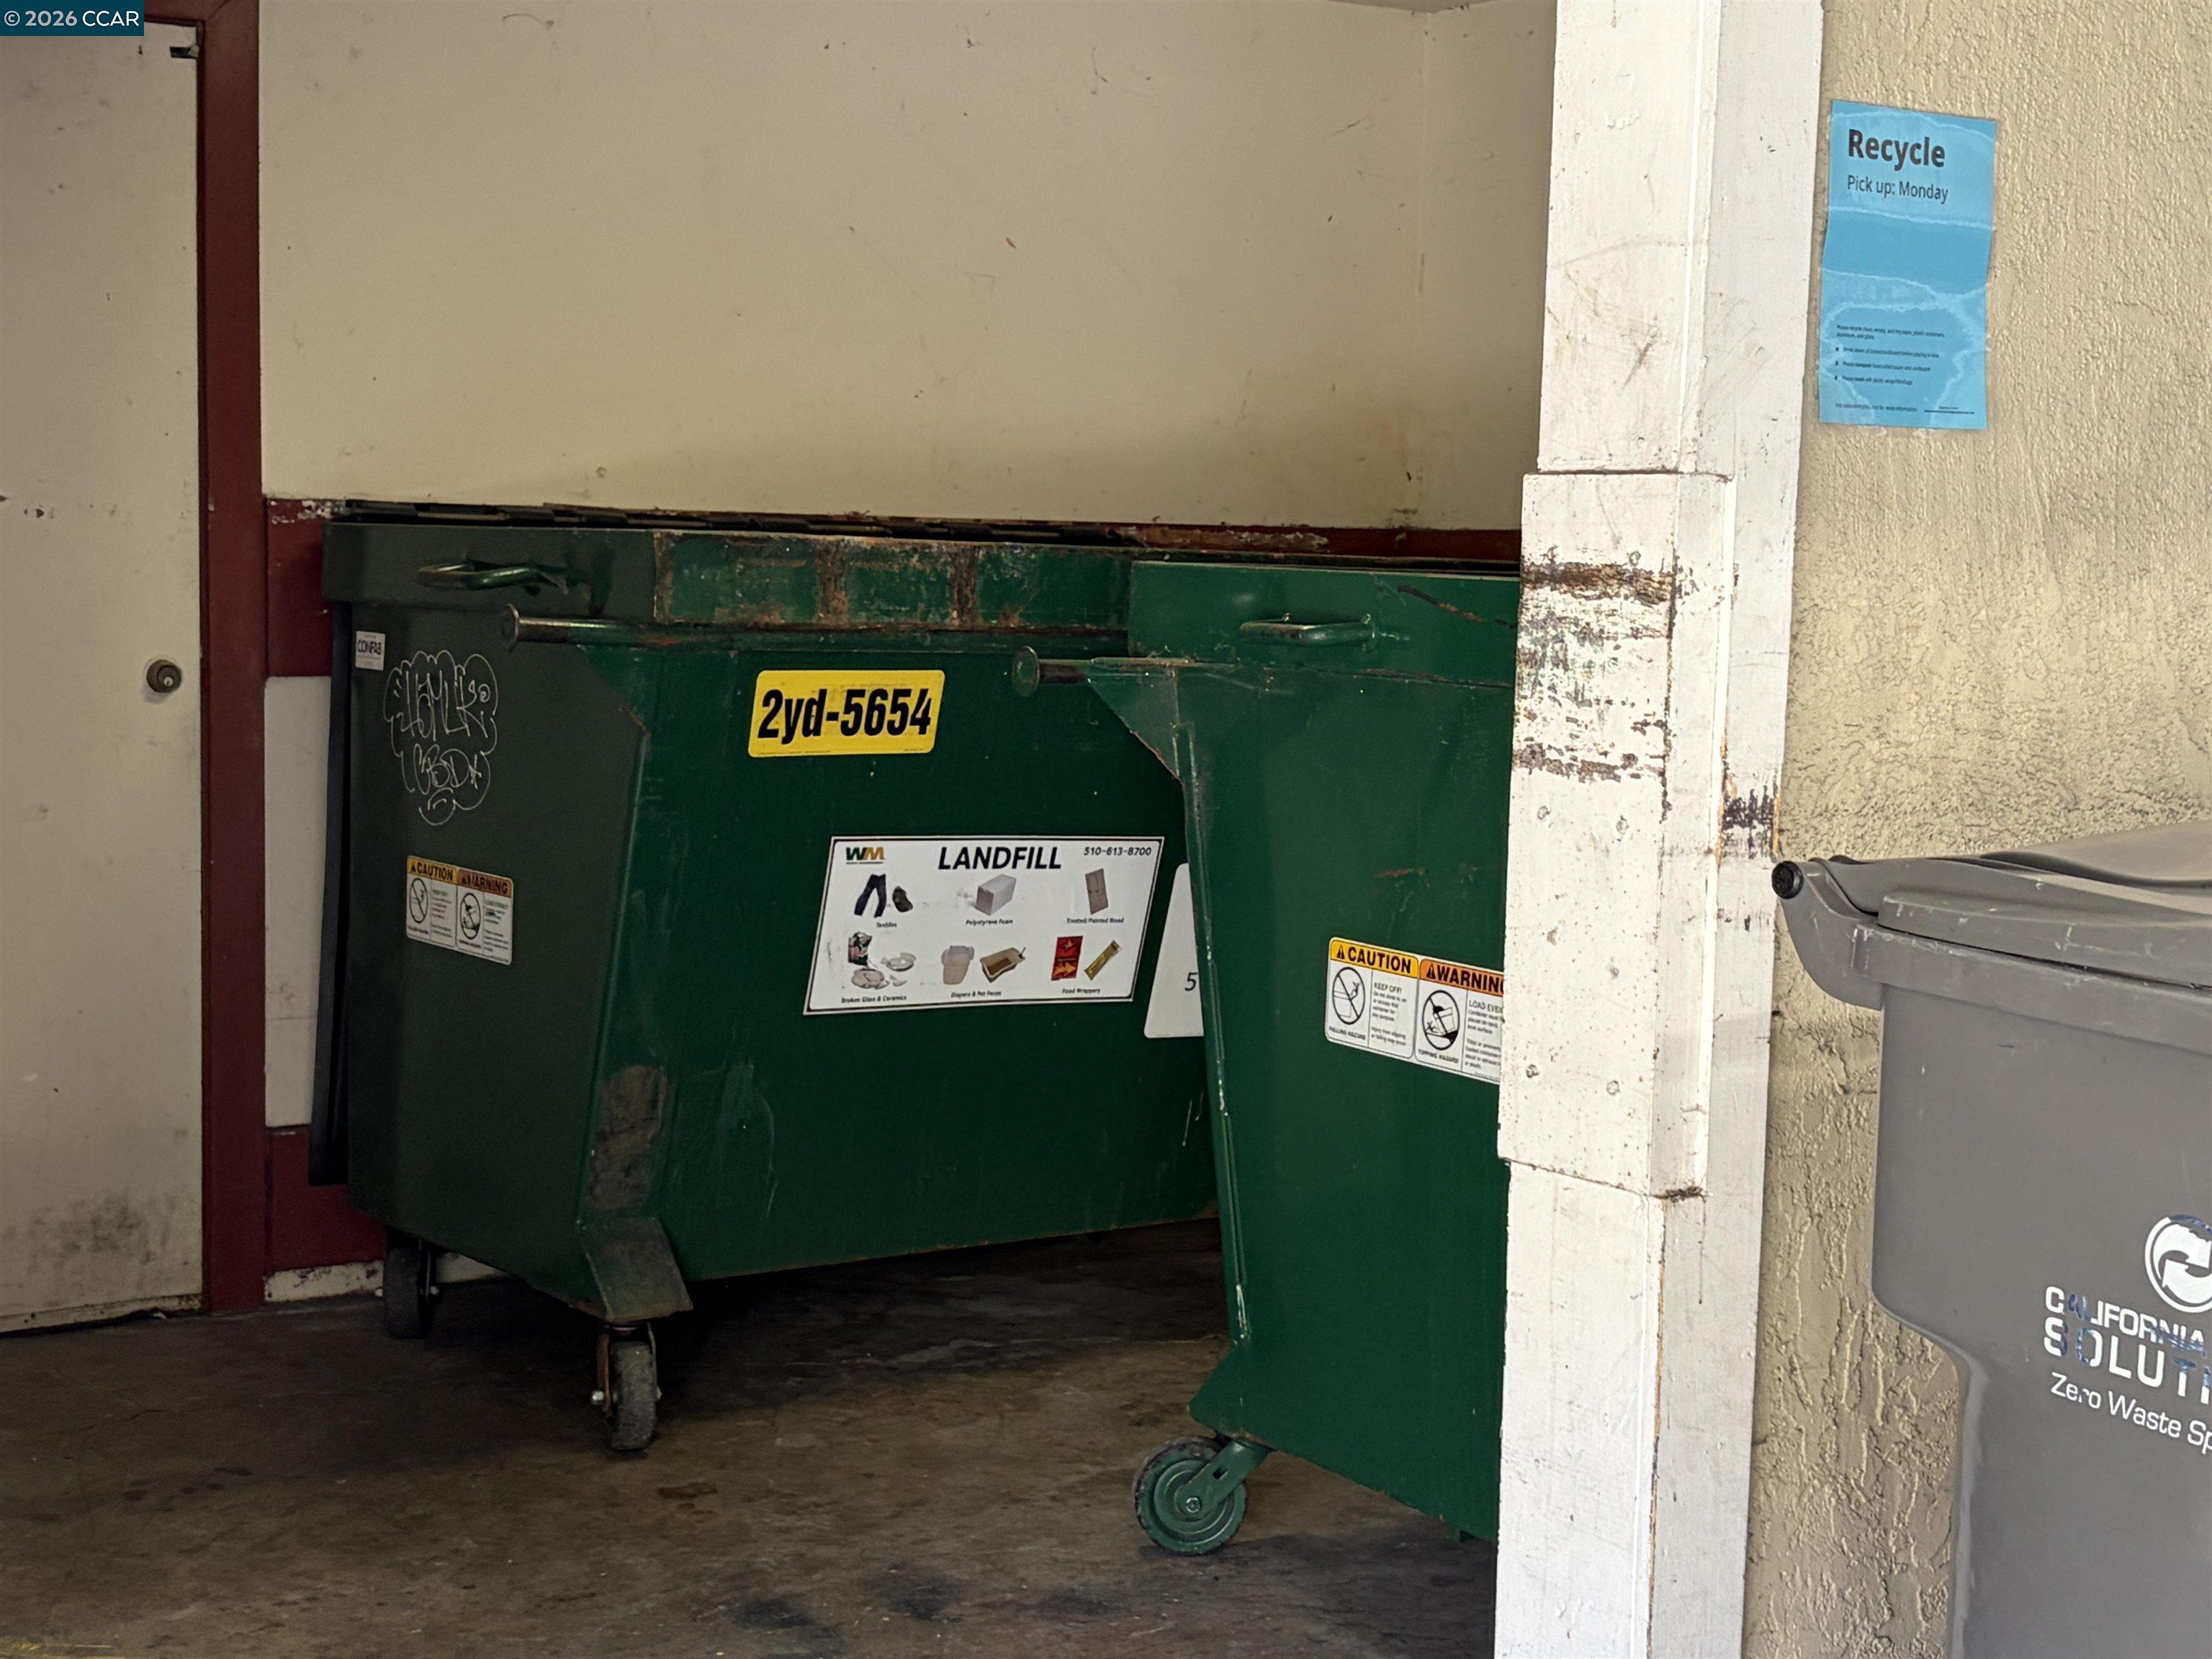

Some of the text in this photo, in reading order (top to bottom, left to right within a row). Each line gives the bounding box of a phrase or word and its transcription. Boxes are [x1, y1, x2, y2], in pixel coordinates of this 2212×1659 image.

[1848, 129, 1945, 171] Recycle
[1848, 175, 1948, 204] Pick up: Monday
[757, 688, 932, 745] 2yd-5654
[846, 847, 886, 860] WM
[938, 847, 1061, 869] LANDFILL
[1084, 847, 1151, 855] 510-613-8700
[416, 863, 508, 894] CAUTION WARNING
[1347, 946, 1411, 974] CAUTION
[2051, 1371, 2101, 1410] Zero
[2108, 1390, 2182, 1439] Waste
